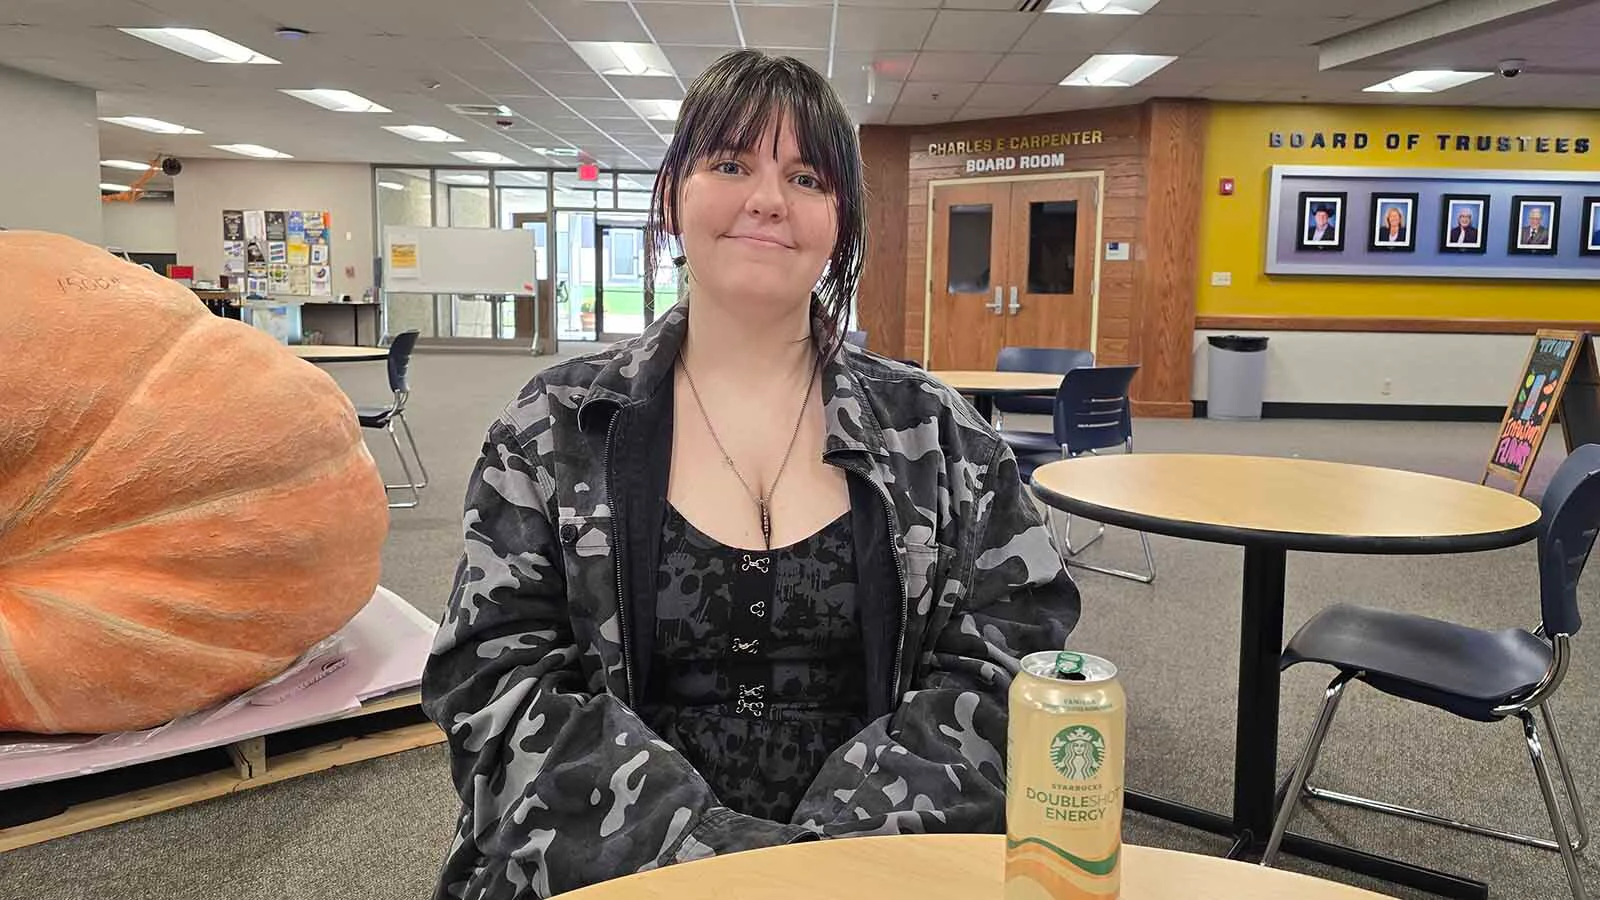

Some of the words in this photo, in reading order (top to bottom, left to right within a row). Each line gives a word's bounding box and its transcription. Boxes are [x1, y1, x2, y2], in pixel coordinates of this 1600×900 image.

[928, 140, 992, 156] CHARLES
[997, 140, 1006, 152] E
[1009, 130, 1103, 150] CARPENTER
[1268, 132, 1368, 149] BOARD
[1386, 133, 1420, 150] OF
[1436, 134, 1590, 154] TRUSTEES
[966, 157, 1016, 173] BOARD
[1020, 153, 1065, 169] ROOM
[1051, 783, 1102, 791] STARBUCKS
[1046, 807, 1106, 822] ENERGY
